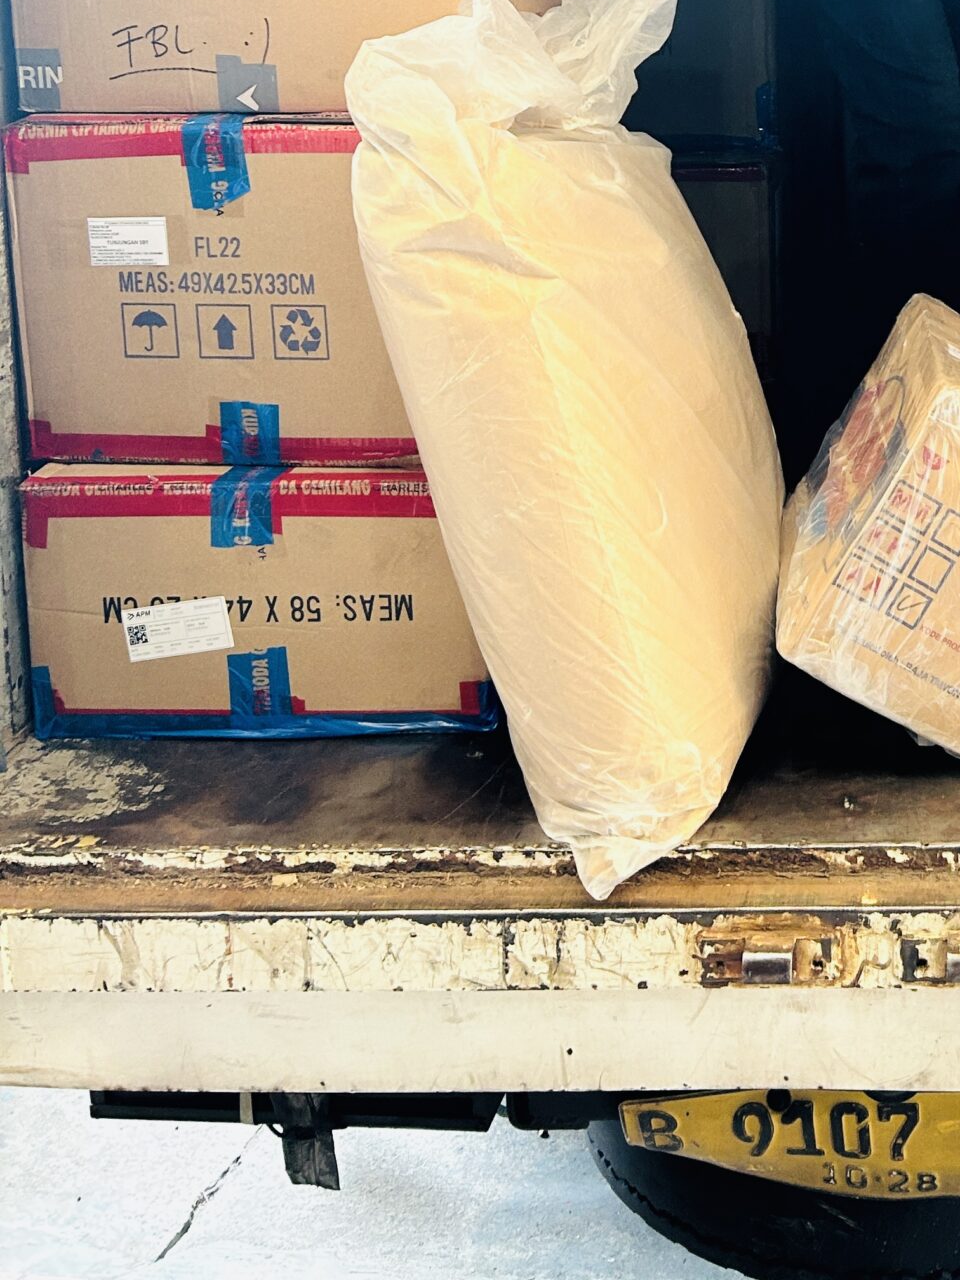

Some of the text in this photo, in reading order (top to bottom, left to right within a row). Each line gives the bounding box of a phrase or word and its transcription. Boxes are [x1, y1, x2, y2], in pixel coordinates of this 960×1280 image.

[194, 236, 241, 259] FL22
[119, 271, 315, 296] MEAS: 49X42.5X33CM
[265, 595, 278, 622] X
[291, 595, 321, 622] 58
[336, 593, 414, 621] MEAS:
[638, 1110, 685, 1152] B
[732, 1101, 921, 1162] 9107
